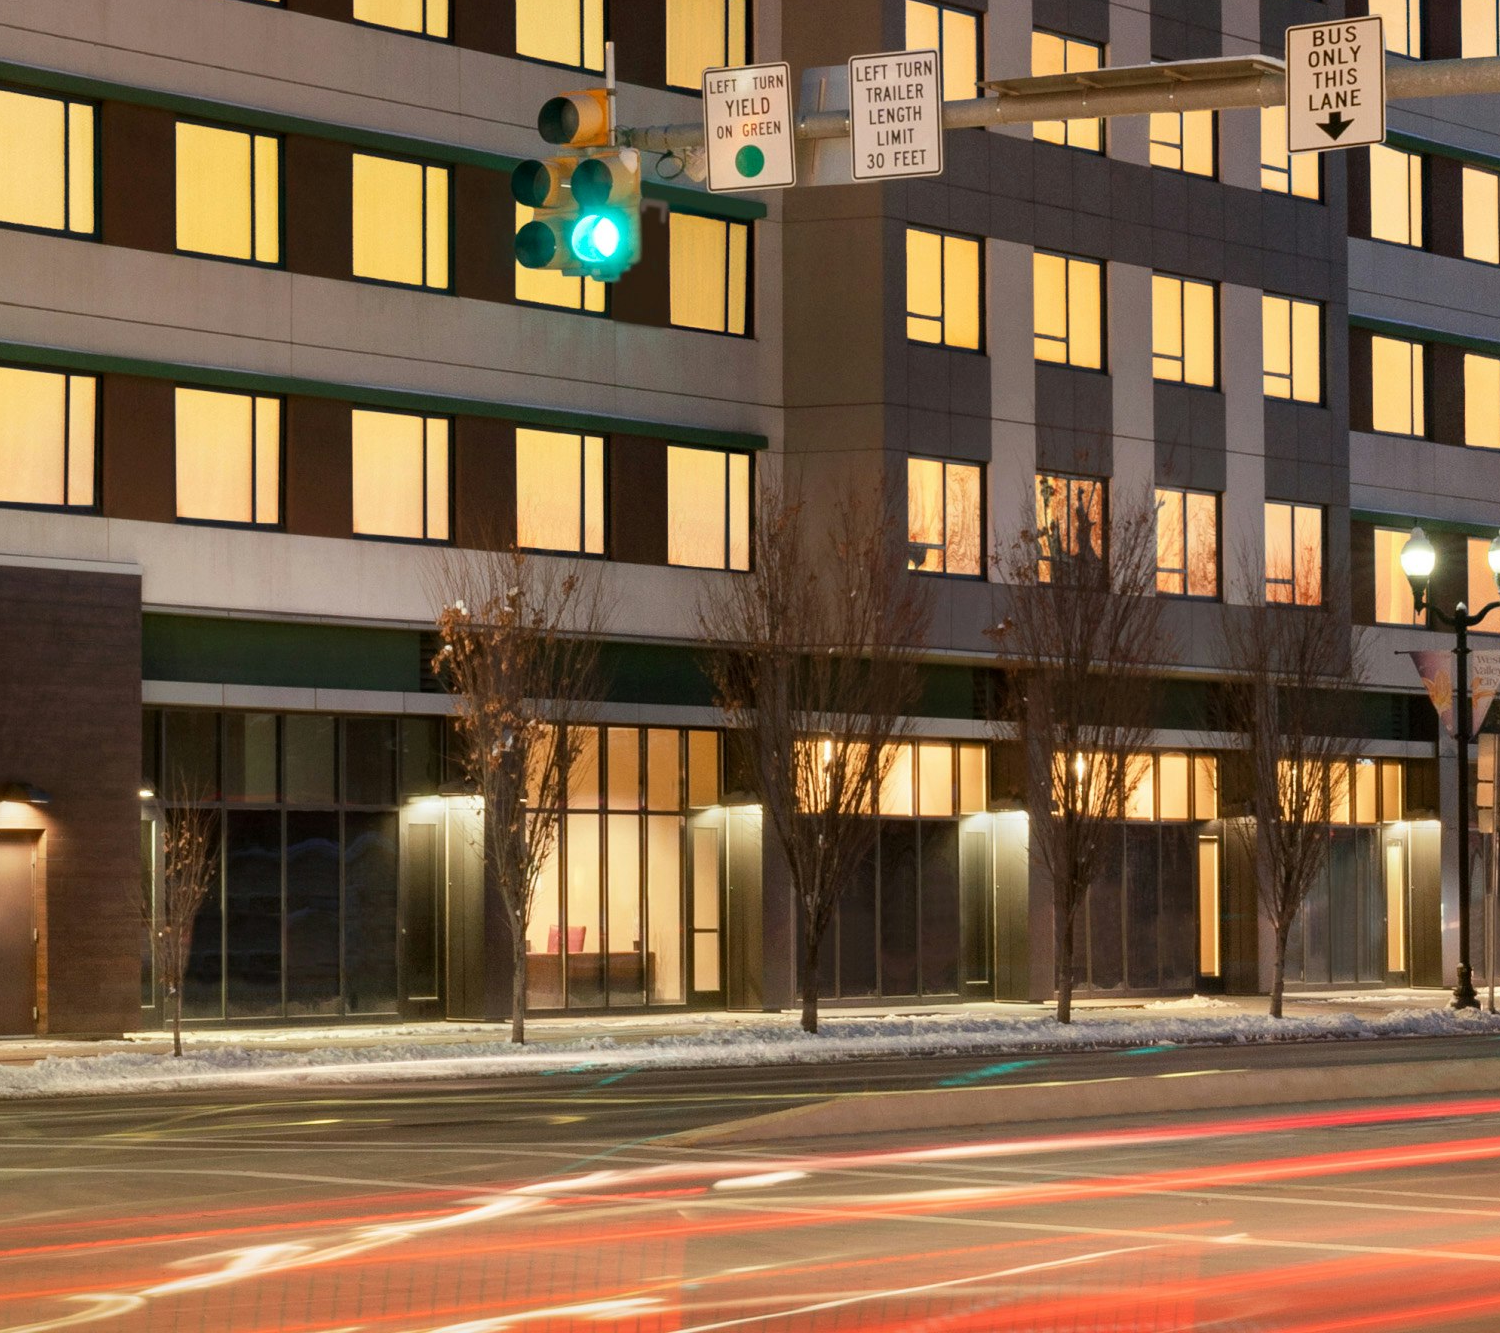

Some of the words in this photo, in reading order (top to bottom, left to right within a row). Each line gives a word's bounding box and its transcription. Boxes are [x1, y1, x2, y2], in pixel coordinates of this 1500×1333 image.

[1313, 26, 1356, 47] BUS
[1308, 45, 1361, 67] ONLY
[856, 64, 888, 82] LEFT
[896, 59, 933, 77] TURN
[1312, 67, 1358, 89] THIS
[709, 78, 737, 94] LEFT
[752, 74, 785, 90] TURN
[866, 83, 924, 103] TRAILER
[725, 97, 771, 118] YIELD
[1309, 89, 1361, 111] LANE
[869, 105, 922, 125] LENGTH
[716, 125, 733, 139] ON
[742, 120, 782, 137] GREEN
[877, 128, 915, 147] LIMIT
[866, 152, 885, 170] 30
[894, 149, 927, 167] FEET
[1479, 678, 1499, 687] City
